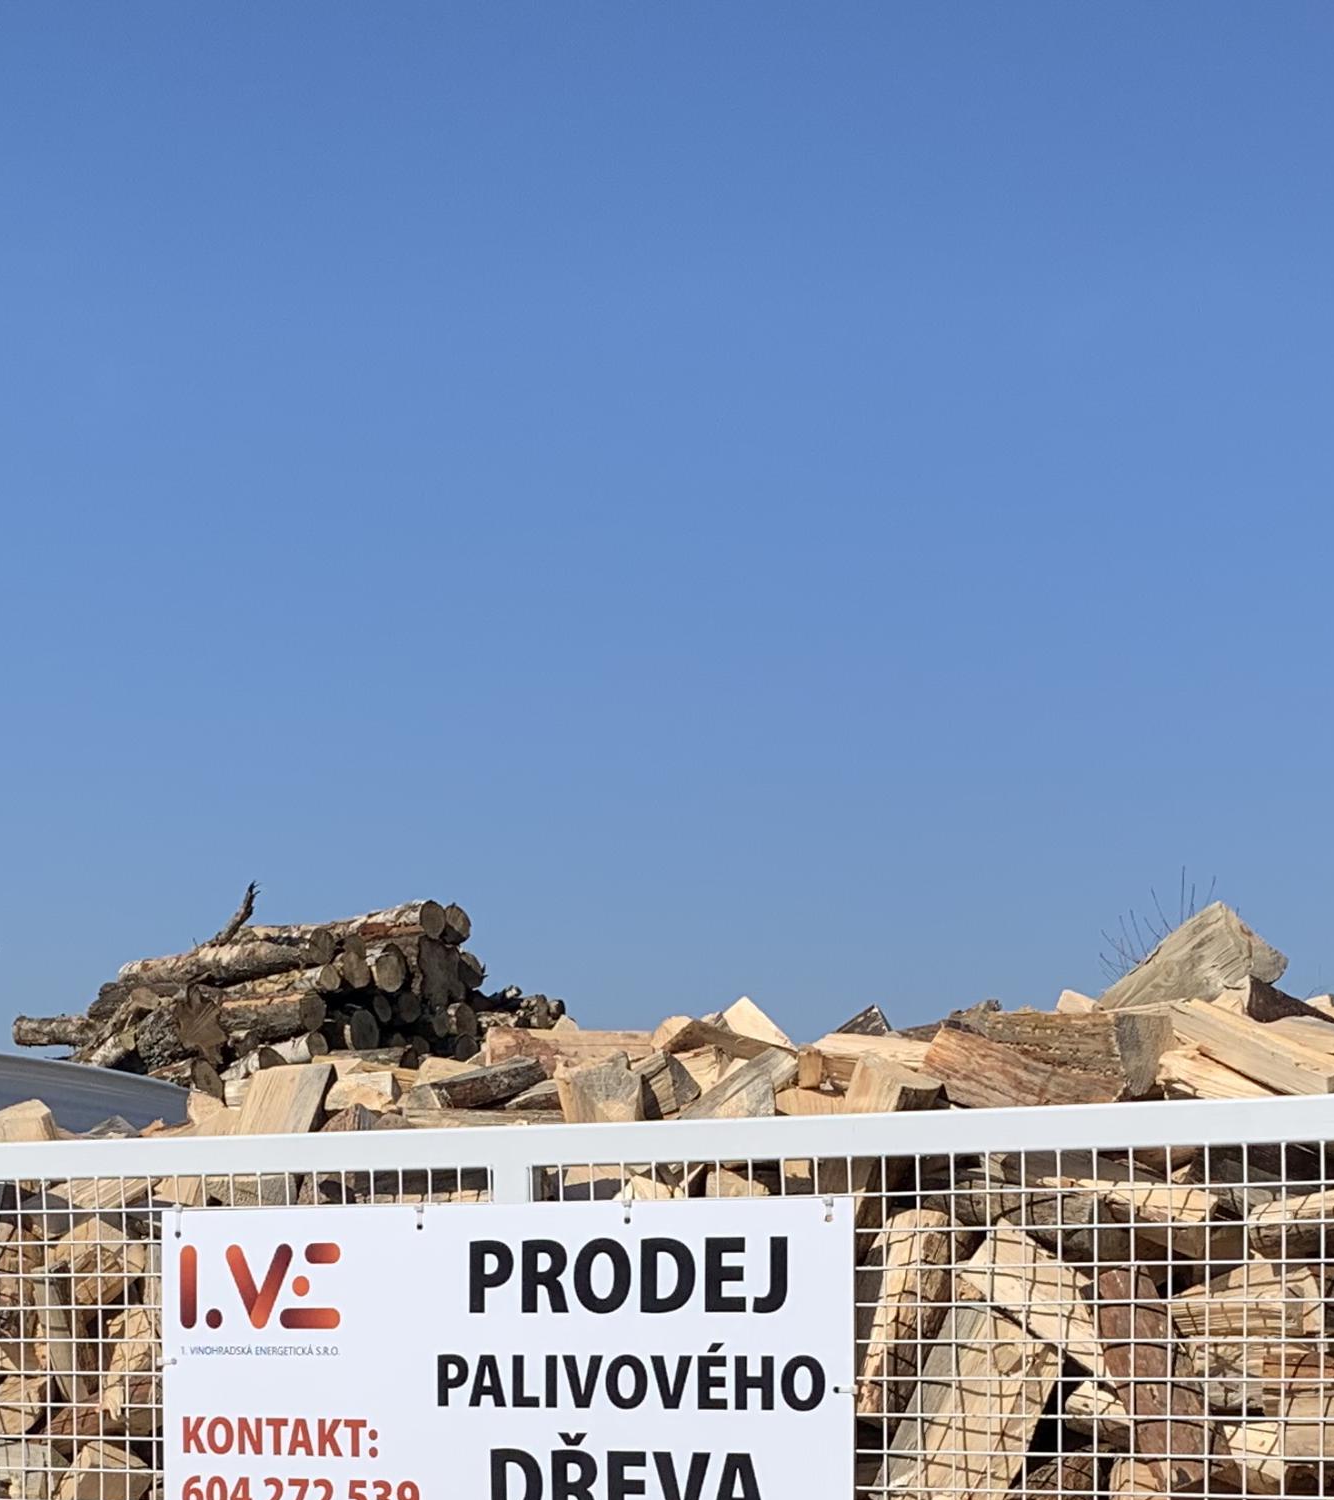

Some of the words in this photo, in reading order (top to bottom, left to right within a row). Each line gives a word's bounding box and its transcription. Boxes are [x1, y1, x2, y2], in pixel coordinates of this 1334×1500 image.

[469, 1236, 789, 1314] PRODEJ
[189, 1343, 253, 1356] VINOHRADSKÁ
[255, 1343, 314, 1357] ENERGETICKÁ
[315, 1345, 341, 1357] S.R.O.
[437, 1342, 826, 1412] PALIVOVÉHO
[182, 1416, 379, 1458] KONTAKT:
